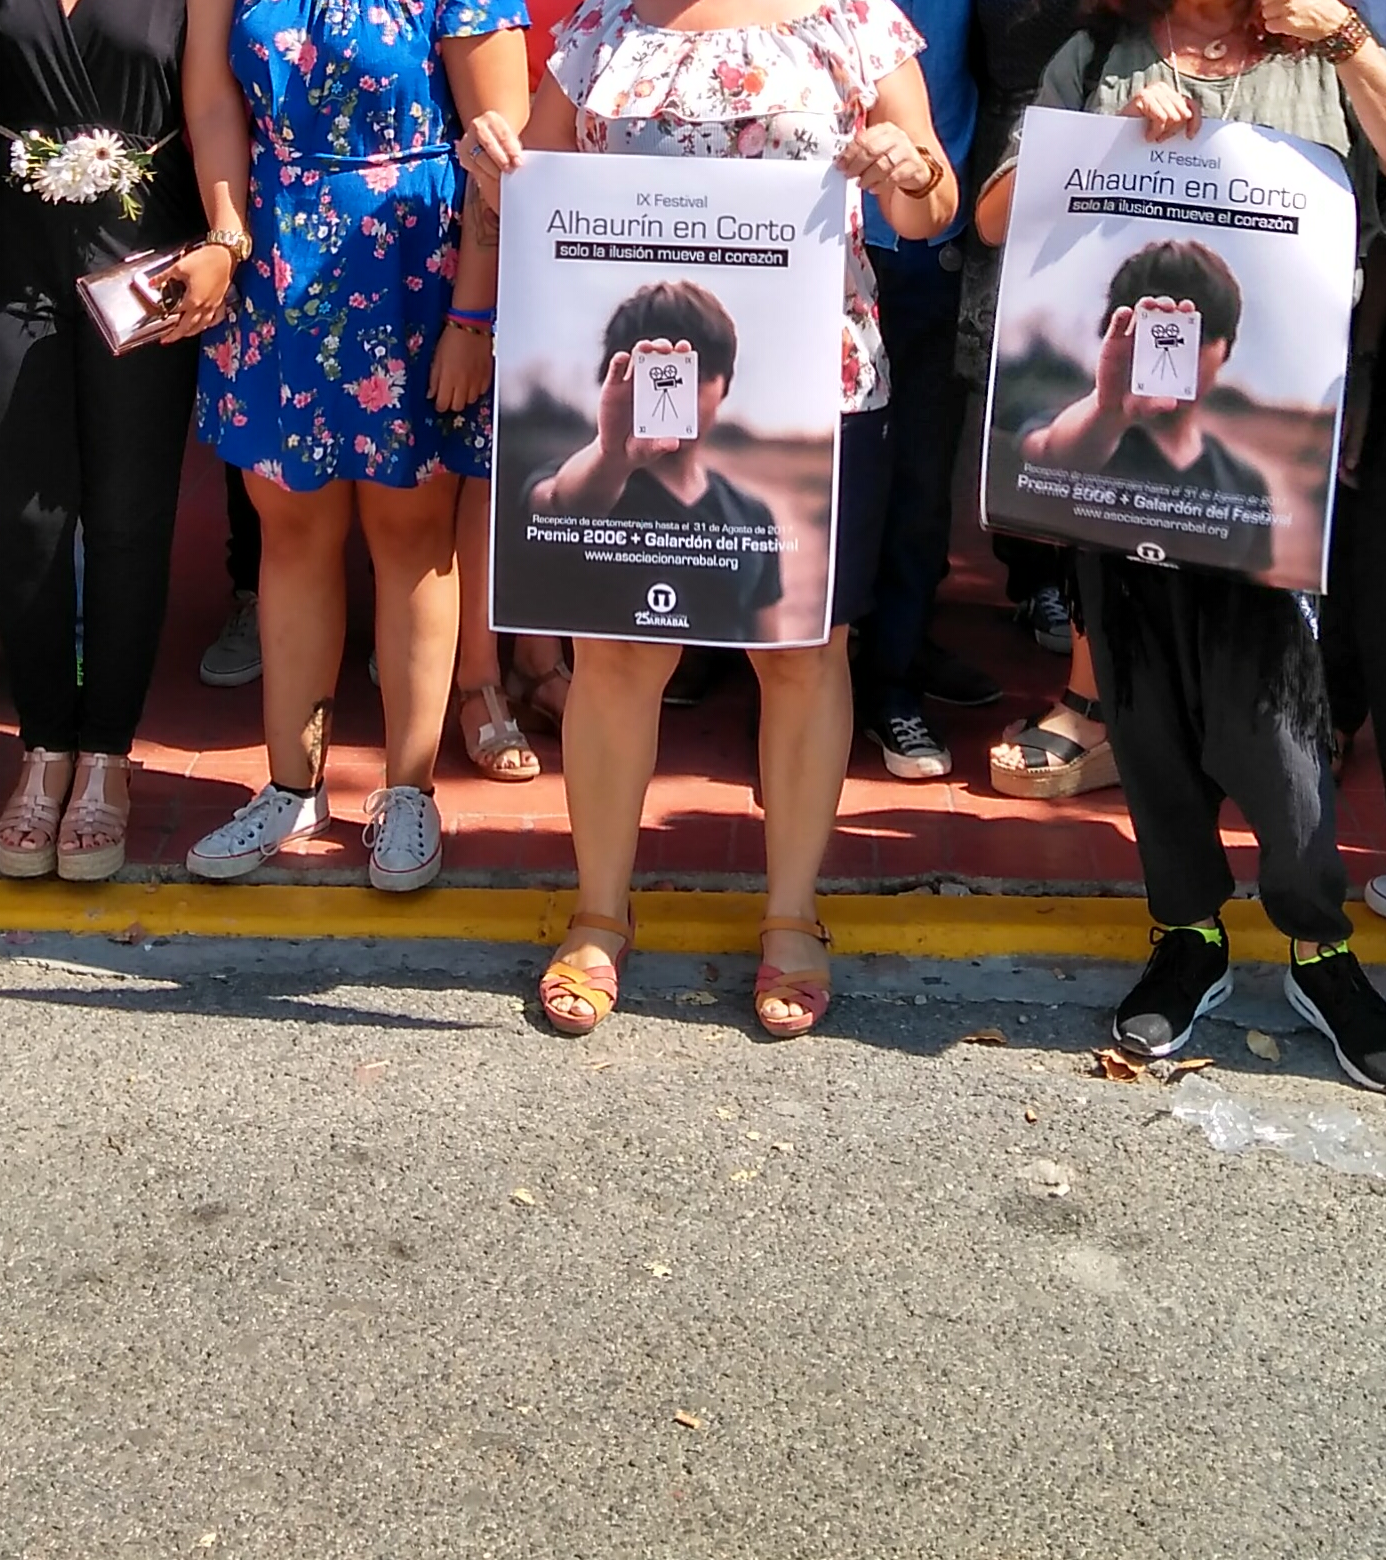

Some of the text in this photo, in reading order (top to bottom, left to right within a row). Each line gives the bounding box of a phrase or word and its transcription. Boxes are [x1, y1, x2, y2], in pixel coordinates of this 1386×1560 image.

[1150, 150, 1221, 170] IX Festival
[636, 193, 708, 208] IX Festival
[1064, 168, 1307, 210] Alhaurín en Corto
[546, 209, 796, 242] Alhaurín en Corto
[1072, 198, 1293, 232] solo la ilusión mueve el corazón
[560, 244, 783, 265] solo la ilusión mueve el corazón
[1133, 494, 1202, 517] Galardón
[1206, 502, 1229, 520] del
[533, 514, 577, 526] Recepción
[579, 517, 590, 526] de
[655, 521, 680, 531] hasta
[682, 522, 689, 531] el
[694, 522, 706, 532] 31
[709, 523, 720, 532] de
[722, 524, 753, 535] Agosto
[755, 525, 766, 534] de
[527, 526, 799, 552] Premio 200€ + Galardón del Festival
[584, 550, 738, 570] www.asociacionarrabal.org
